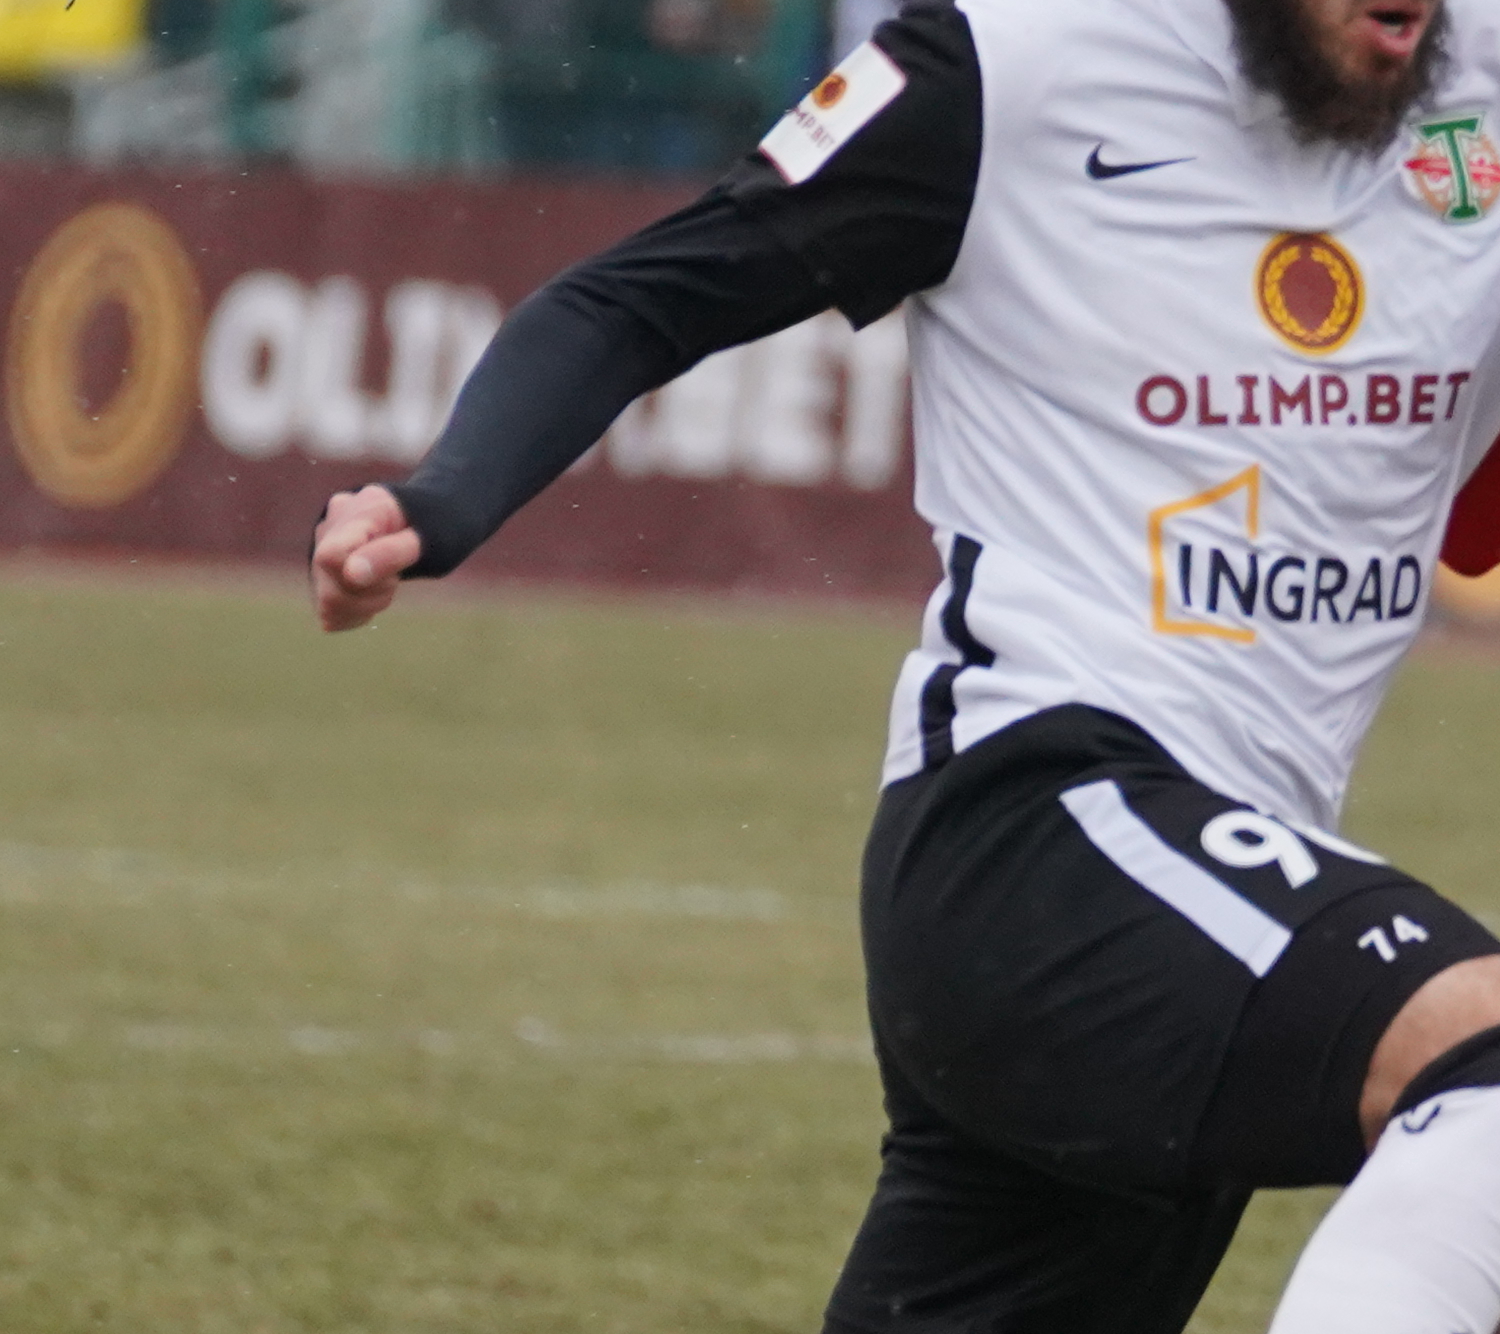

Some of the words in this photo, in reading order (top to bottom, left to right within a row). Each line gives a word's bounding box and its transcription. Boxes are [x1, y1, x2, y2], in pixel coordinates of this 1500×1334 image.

[792, 106, 836, 150] MP.BET
[202, 270, 906, 489] OLI.BET
[1135, 370, 1472, 427] OLIMP.BET
[1177, 543, 1422, 624] INGRAD
[1200, 809, 1375, 890] 9
[1357, 913, 1429, 963] 74
